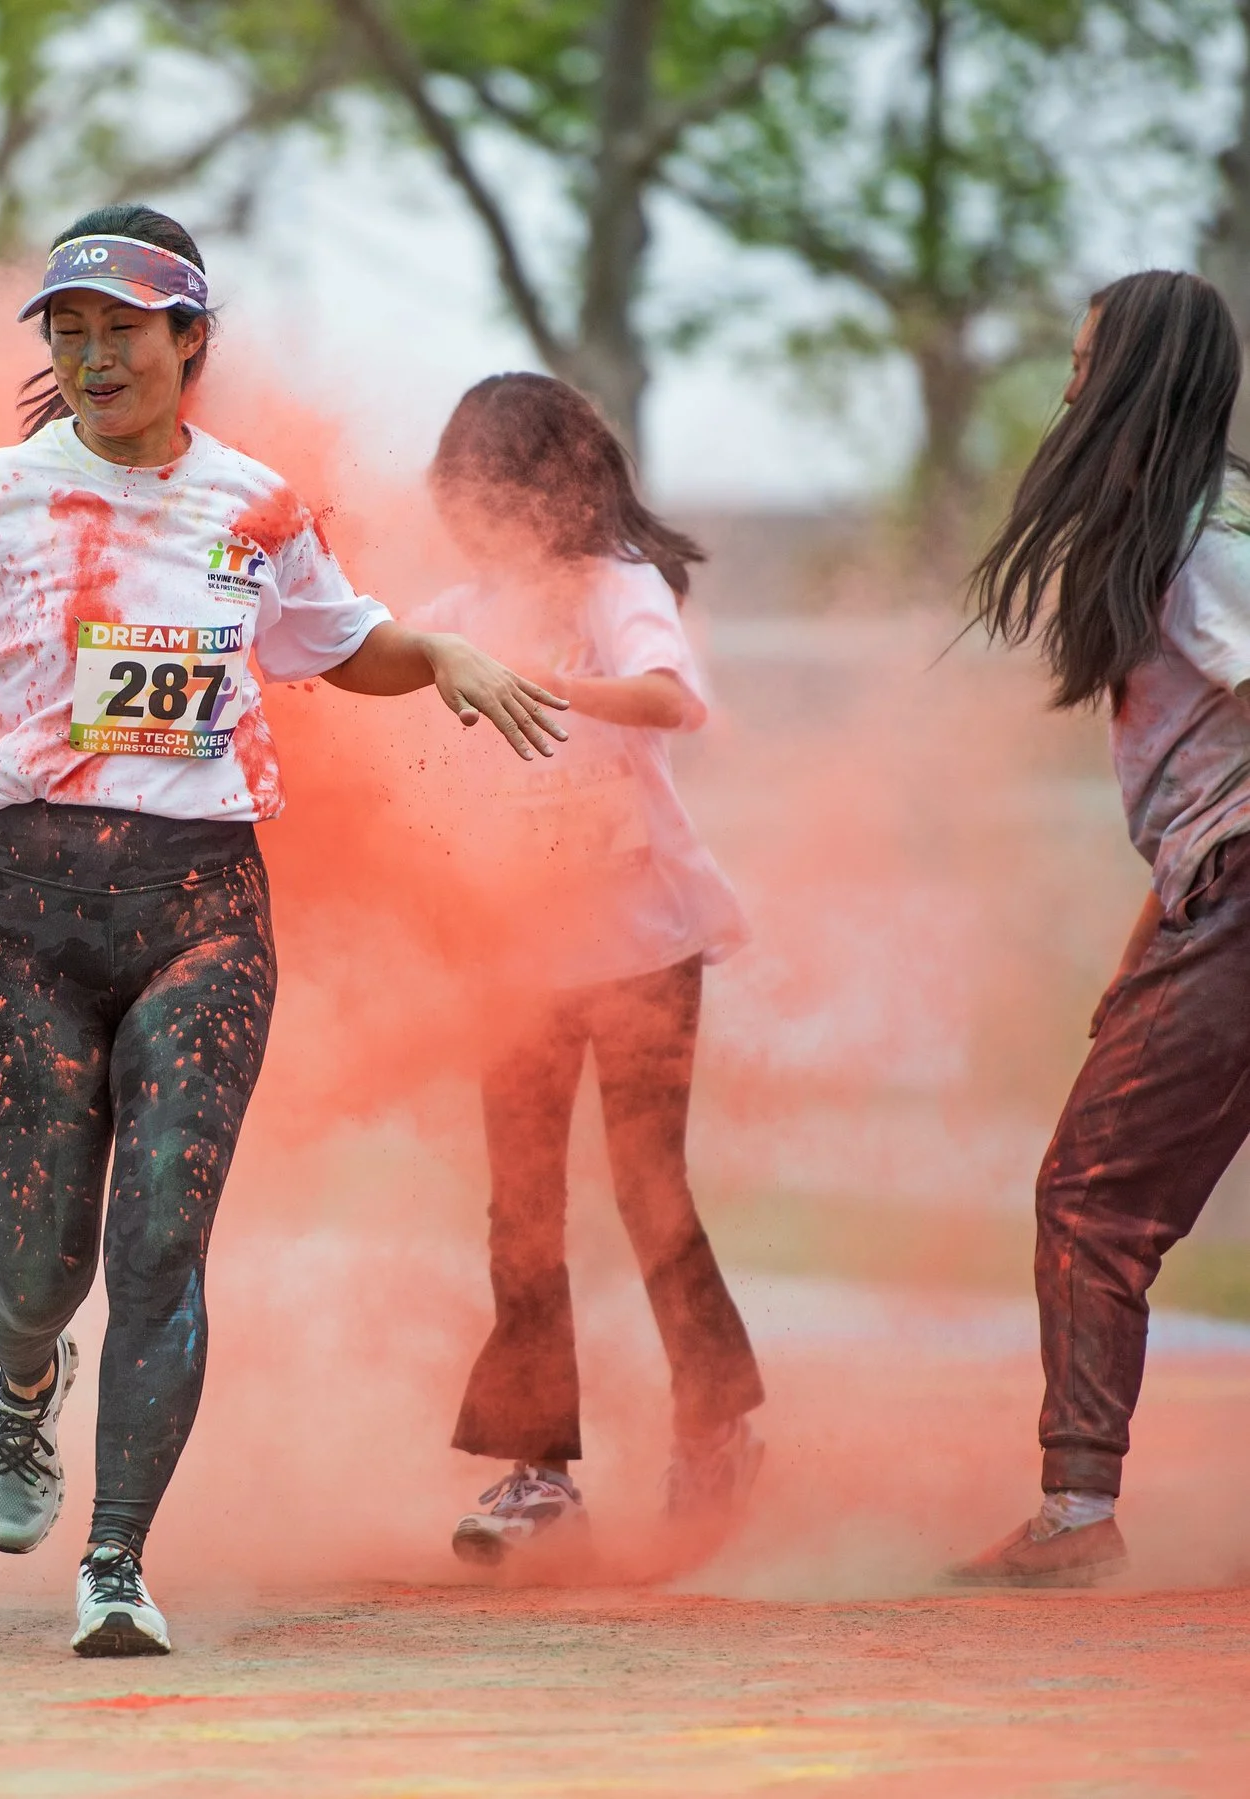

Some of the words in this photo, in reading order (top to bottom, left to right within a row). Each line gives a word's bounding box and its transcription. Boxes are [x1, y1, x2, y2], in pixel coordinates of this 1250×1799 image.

[207, 574, 232, 583] IRVINE
[91, 625, 189, 650] DREAM
[197, 627, 242, 650] RUN
[105, 661, 226, 721] 287
[83, 729, 140, 743] IRVINE
[144, 732, 188, 746] TECH
[193, 733, 232, 747] WEEK
[83, 741, 98, 750] 5K
[101, 743, 110, 751] &
[113, 744, 170, 755] FIRSTGEN
[172, 747, 213, 758] COLOR
